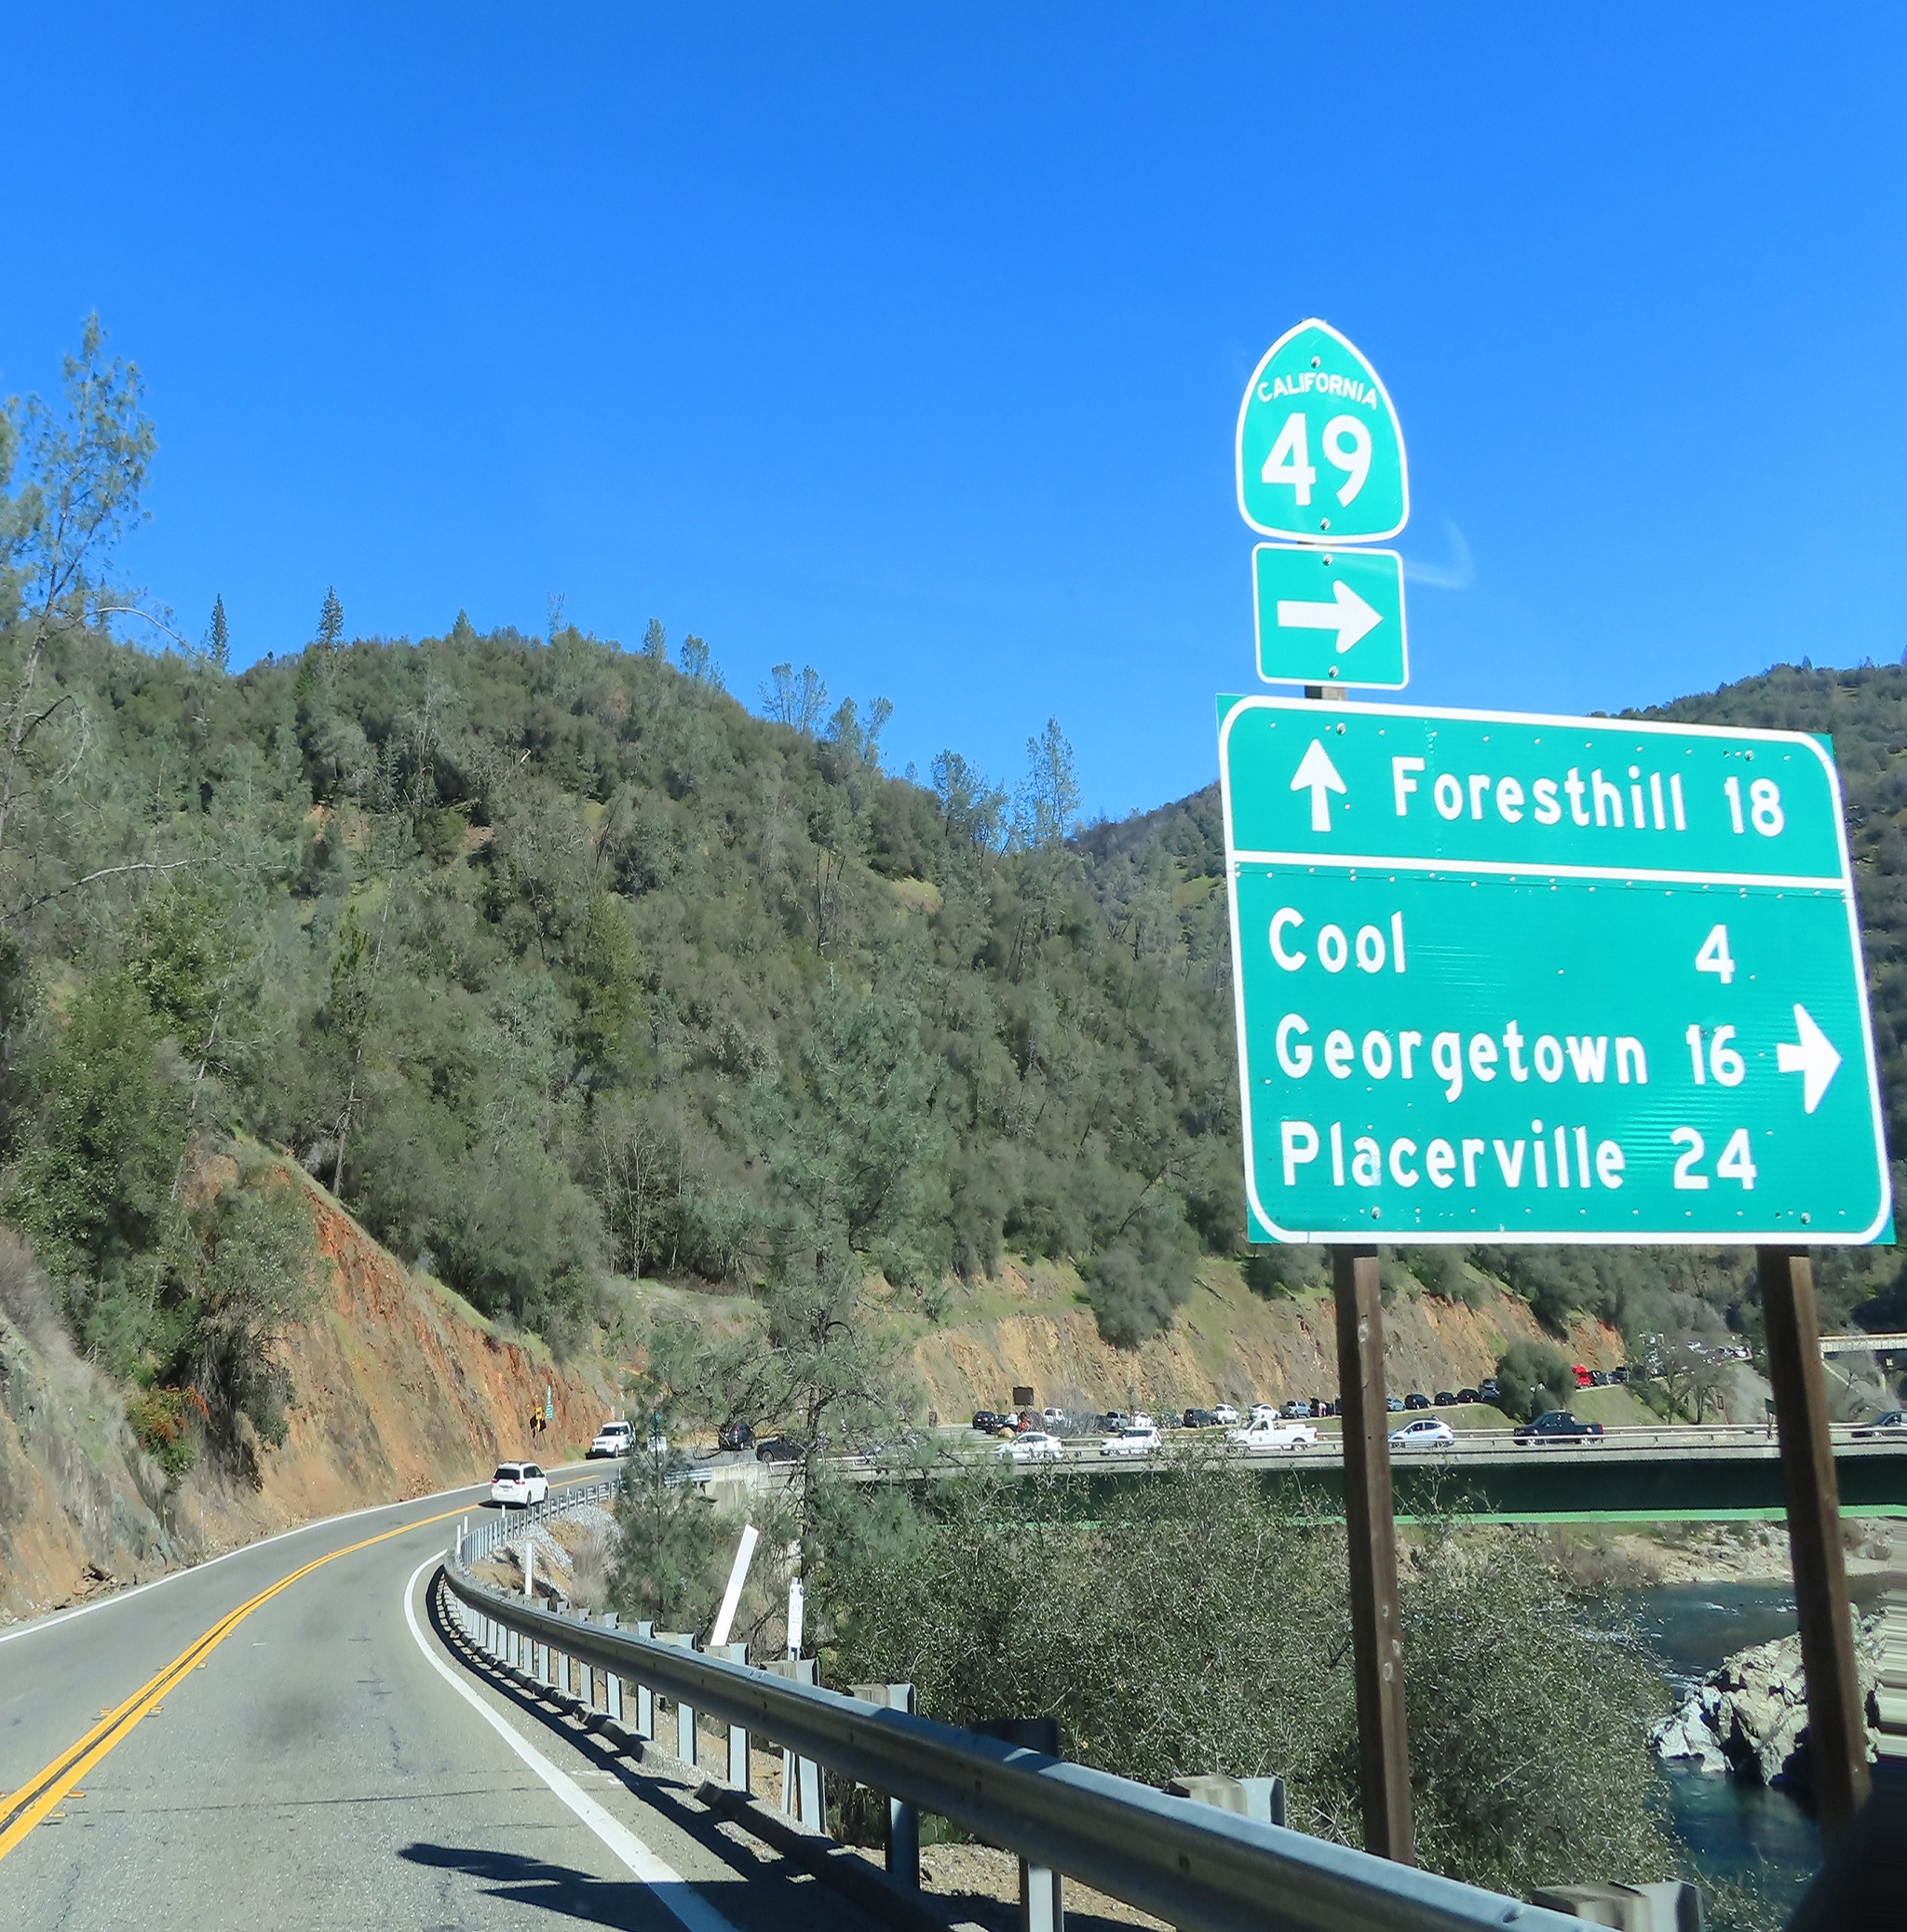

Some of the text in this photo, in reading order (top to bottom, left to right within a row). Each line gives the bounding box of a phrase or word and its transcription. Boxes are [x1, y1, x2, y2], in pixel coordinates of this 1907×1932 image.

[1258, 372, 1377, 410] CALIFORNIA
[1262, 412, 1373, 507] 49
[1392, 756, 1784, 836] Foresthill 18
[1269, 908, 1735, 983] Cool 4
[1276, 1014, 1746, 1102] Georgetown 16
[1281, 1119, 1757, 1190] Placerville 24
